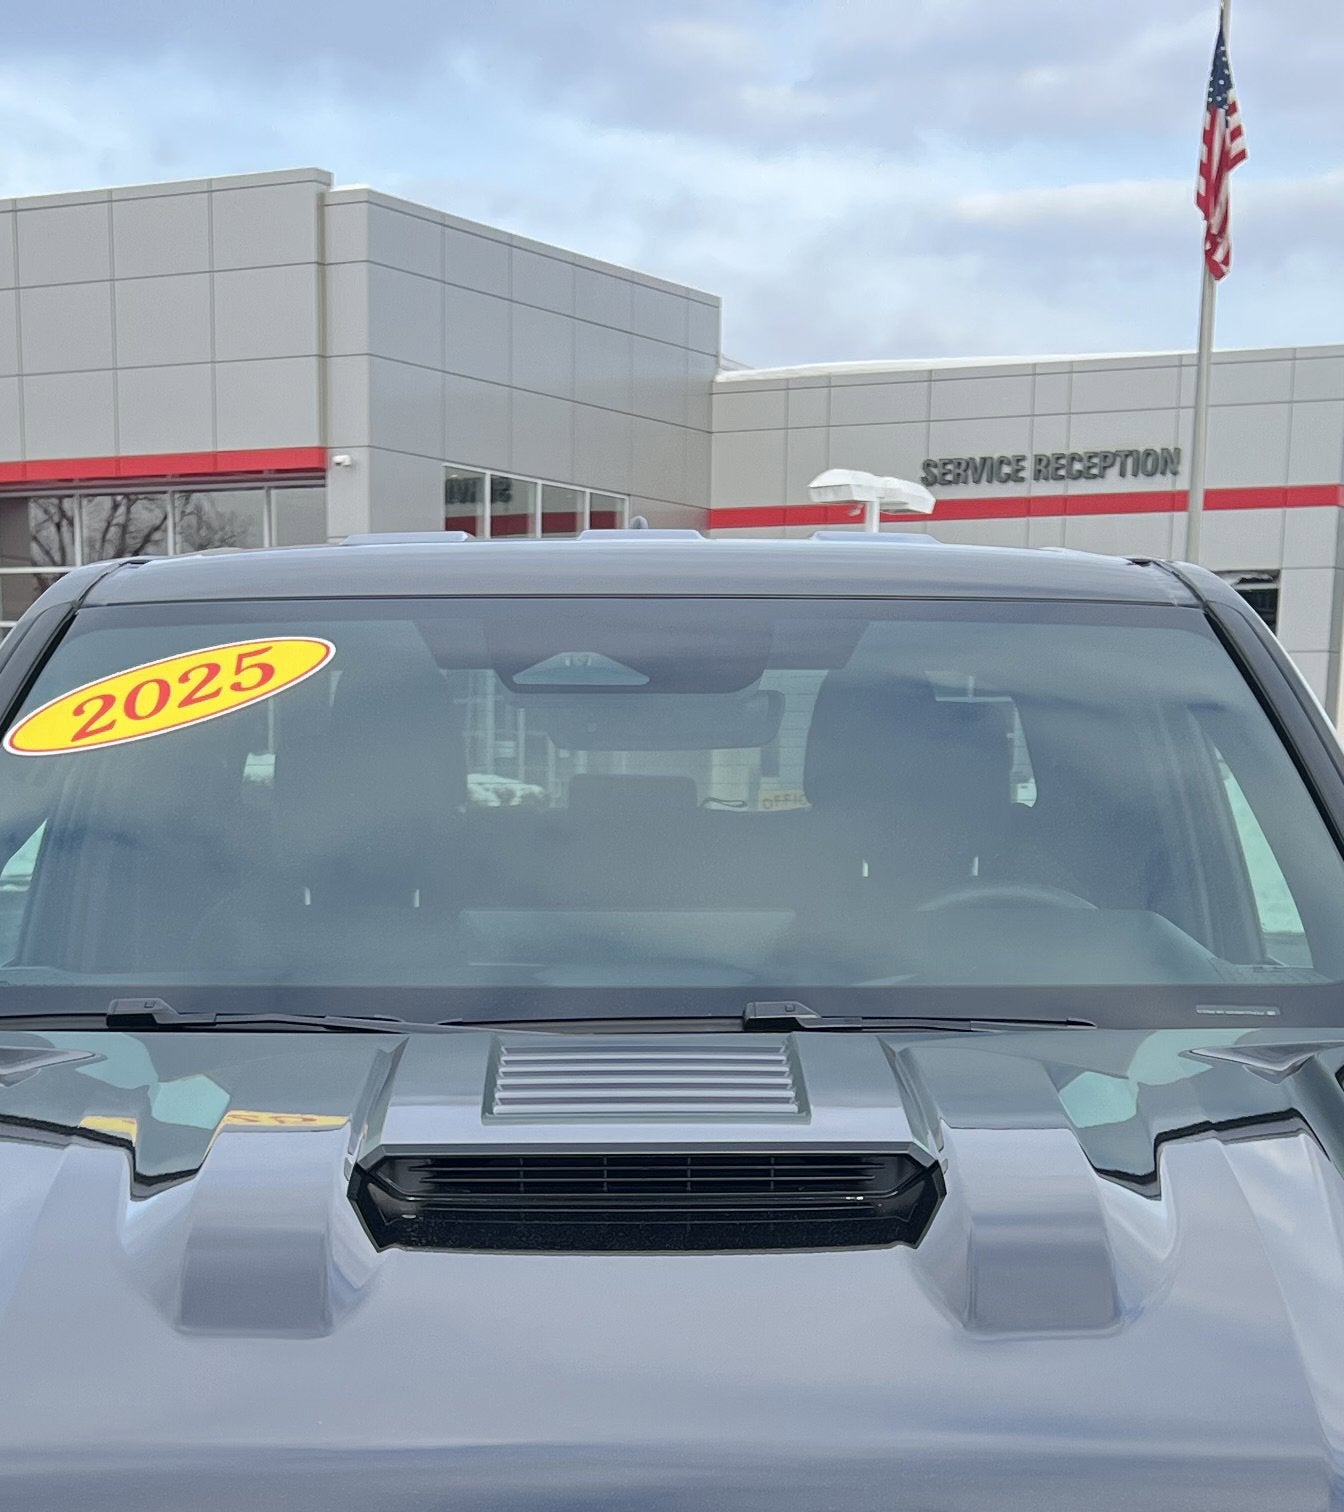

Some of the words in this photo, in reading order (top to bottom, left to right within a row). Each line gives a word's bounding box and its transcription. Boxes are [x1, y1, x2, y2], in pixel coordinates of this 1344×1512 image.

[921, 455, 1026, 487] SERVICE
[1033, 447, 1181, 482] RECEPTION
[70, 646, 276, 742] 2025
